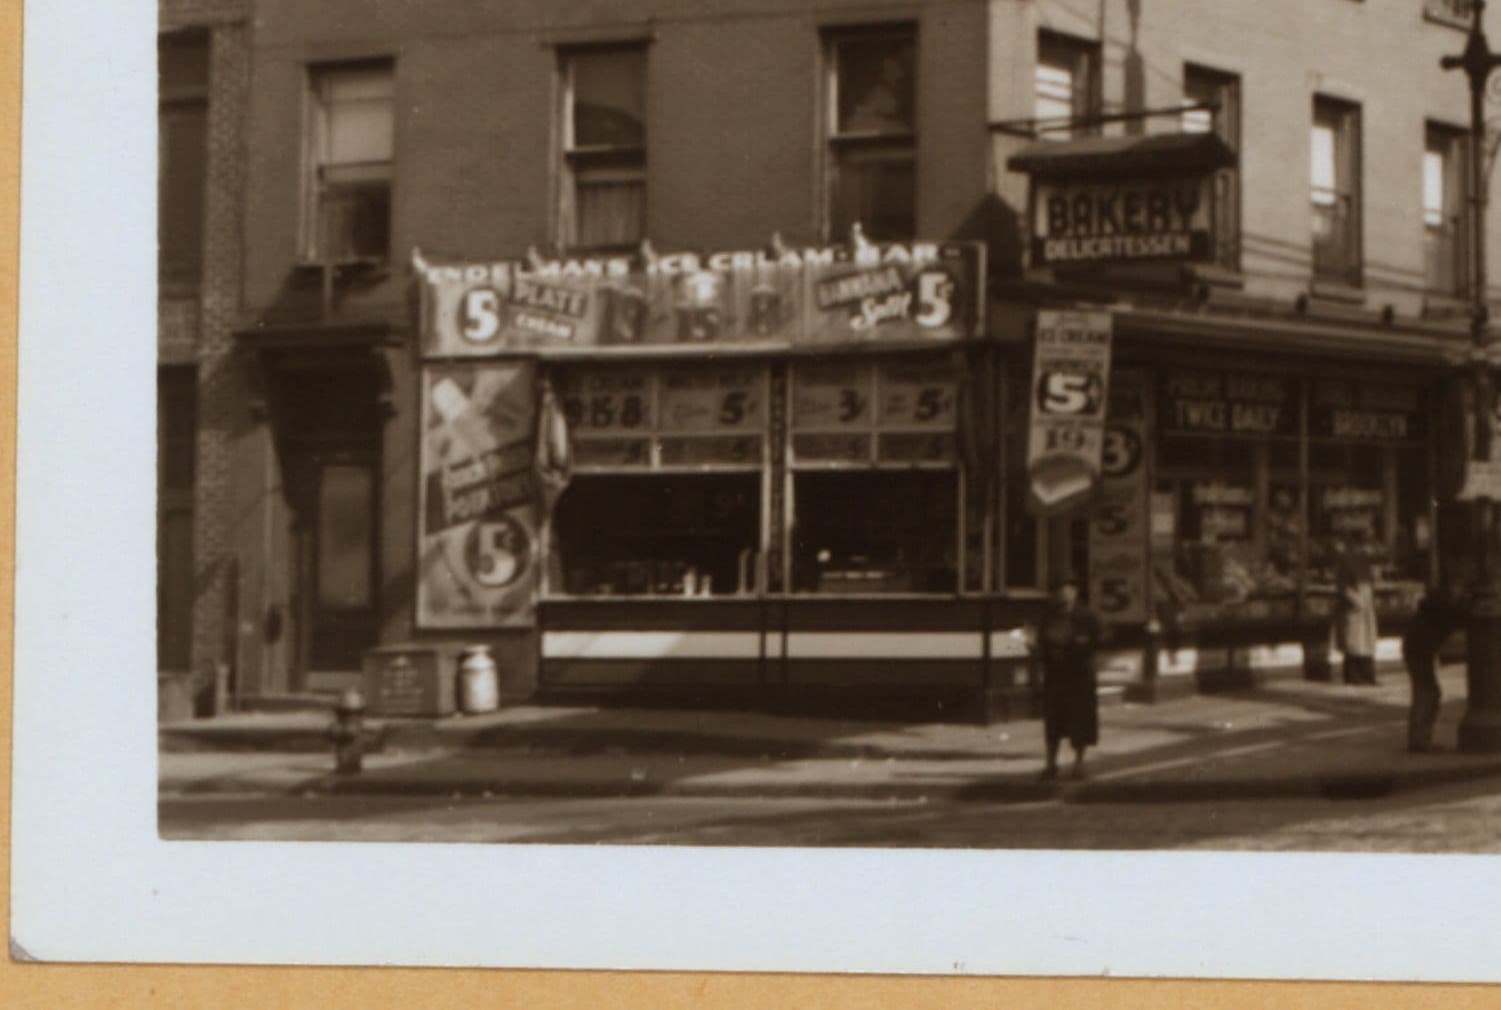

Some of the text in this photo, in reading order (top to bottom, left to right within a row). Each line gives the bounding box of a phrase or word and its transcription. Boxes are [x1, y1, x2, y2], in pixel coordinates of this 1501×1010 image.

[1047, 190, 1200, 236] BAKERY
[708, 248, 835, 271] CREAM
[1044, 235, 1191, 261] DELICATESSEN
